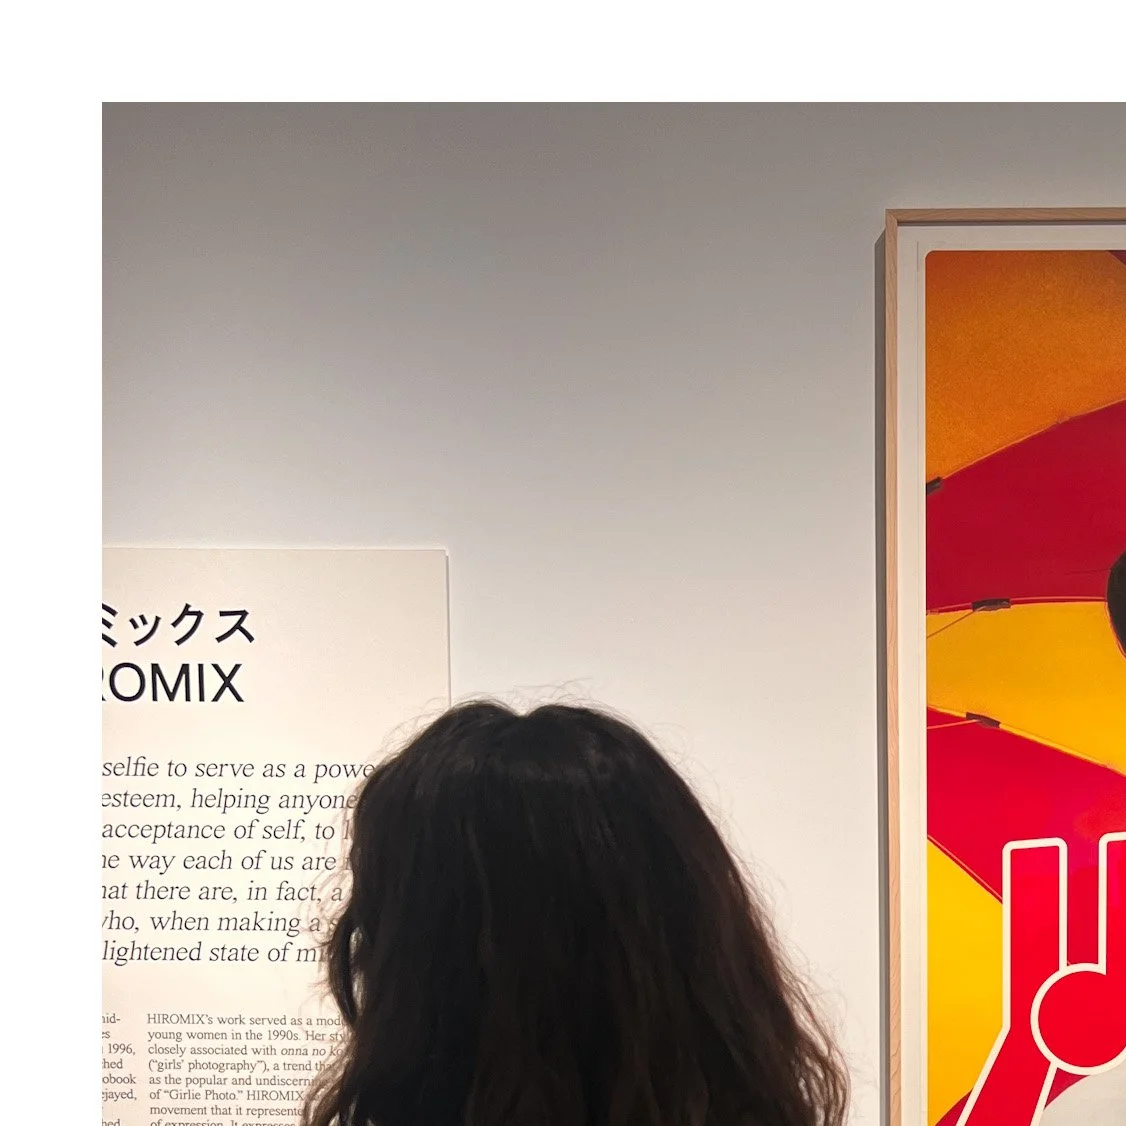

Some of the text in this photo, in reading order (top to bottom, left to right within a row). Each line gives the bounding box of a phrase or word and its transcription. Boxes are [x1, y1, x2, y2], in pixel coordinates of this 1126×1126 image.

[102, 662, 245, 702] OMIX
[102, 756, 159, 777] selfie
[168, 760, 187, 777] to
[195, 763, 254, 778] serve
[263, 764, 286, 778] as
[294, 764, 306, 778] a
[102, 790, 181, 812] esteem,
[190, 788, 271, 814] helping
[102, 822, 225, 844] acceptance
[234, 819, 259, 839] of
[263, 819, 305, 841] self,
[316, 823, 334, 840] to
[129, 855, 175, 875] way
[183, 850, 232, 869] each
[241, 849, 266, 870] of
[271, 856, 294, 870] us
[302, 856, 337, 871] are
[136, 880, 190, 900] there
[199, 886, 237, 902] are,
[247, 881, 267, 900] in
[276, 881, 322, 903] fact,
[150, 911, 208, 931] when
[217, 911, 301, 937] making
[102, 940, 202, 967] lightened
[209, 944, 259, 962] state
[268, 942, 293, 962] of
[217, 1014, 246, 1026] work
[249, 1014, 287, 1027] served
[290, 1017, 304, 1027] as
[306, 1018, 313, 1027] a
[148, 1032, 182, 1042] young
[186, 1032, 227, 1040] women
[232, 1030, 242, 1040] in
[245, 1029, 263, 1041] the
[268, 1029, 300, 1041] 1990s.
[304, 1031, 326, 1041] Her
[108, 1043, 135, 1056] 1996,
[148, 1044, 187, 1058] closely
[190, 1045, 248, 1055] associated
[251, 1045, 277, 1056] with
[281, 1047, 308, 1057] onna
[312, 1048, 326, 1057] no
[273, 1063, 280, 1071] a
[283, 1060, 312, 1072] trend
[149, 1076, 161, 1084] as
[164, 1074, 182, 1085] the
[185, 1074, 228, 1088] popular
[231, 1075, 252, 1086] and
[150, 1089, 162, 1100] of
[150, 1105, 207, 1116] movement
[211, 1105, 232, 1116] that
[236, 1105, 242, 1116] it
